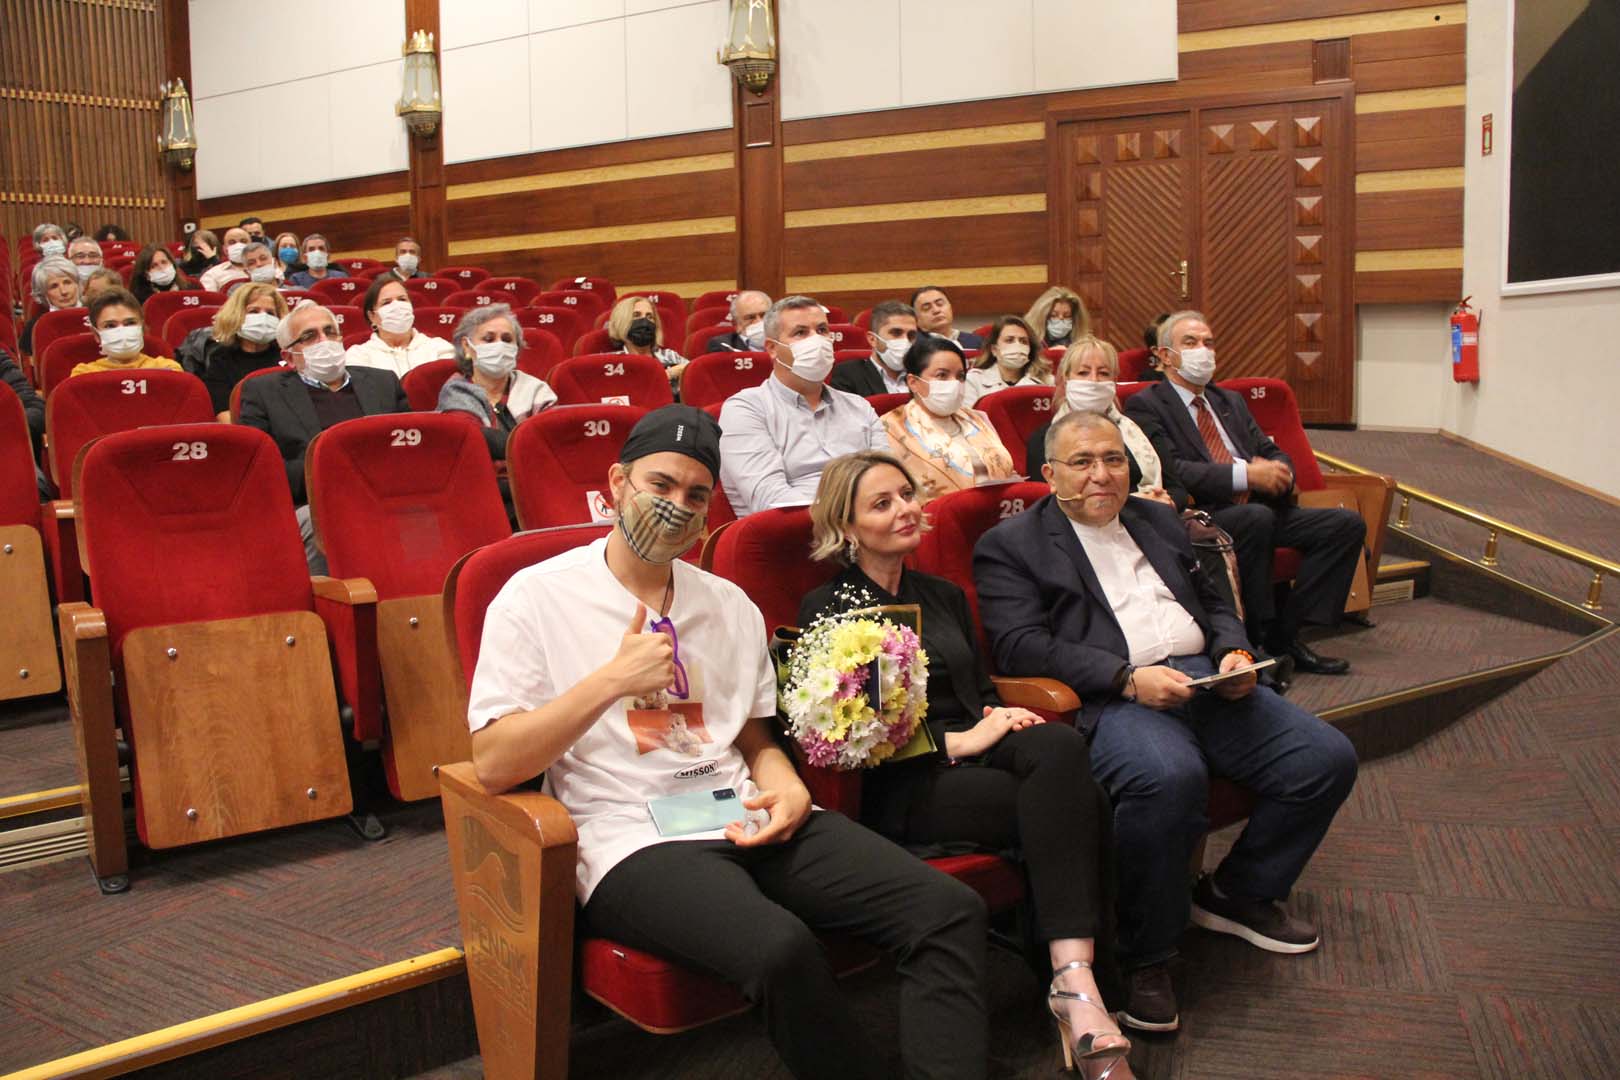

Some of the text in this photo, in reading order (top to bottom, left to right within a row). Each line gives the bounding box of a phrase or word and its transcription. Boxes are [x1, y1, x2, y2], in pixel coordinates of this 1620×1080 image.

[563, 296, 577, 305] 40
[439, 314, 455, 324] 37
[539, 314, 554, 323] 38
[604, 363, 624, 376] 34
[735, 358, 753, 370] 35
[121, 380, 147, 394] 31
[1251, 387, 1265, 399] 35
[1033, 398, 1050, 411] 33
[584, 420, 610, 436] 30
[391, 429, 421, 446] 29
[173, 442, 208, 461] 28
[1000, 498, 1024, 518] 28
